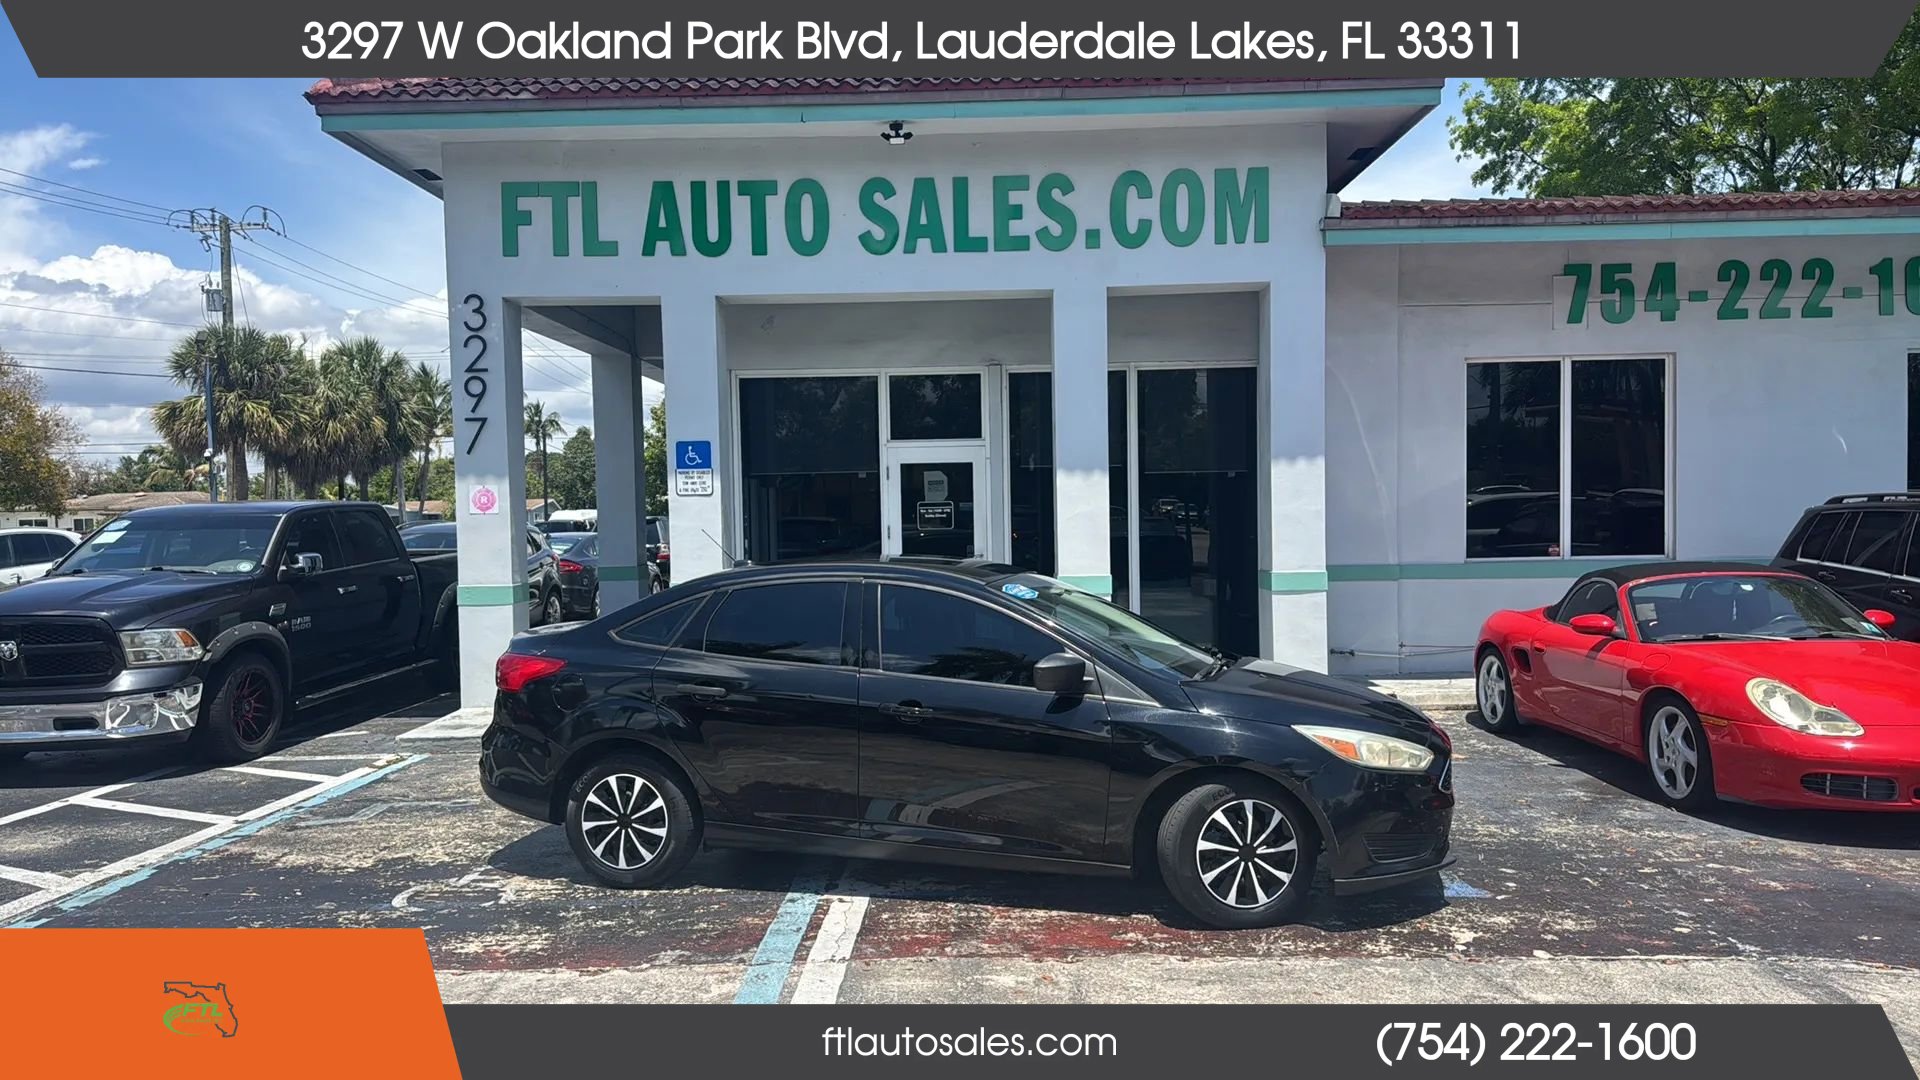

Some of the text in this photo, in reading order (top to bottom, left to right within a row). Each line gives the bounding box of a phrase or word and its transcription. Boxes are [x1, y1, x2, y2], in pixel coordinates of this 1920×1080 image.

[500, 166, 1270, 258] FTL AUTO SALES.COM
[463, 293, 489, 455] 3297
